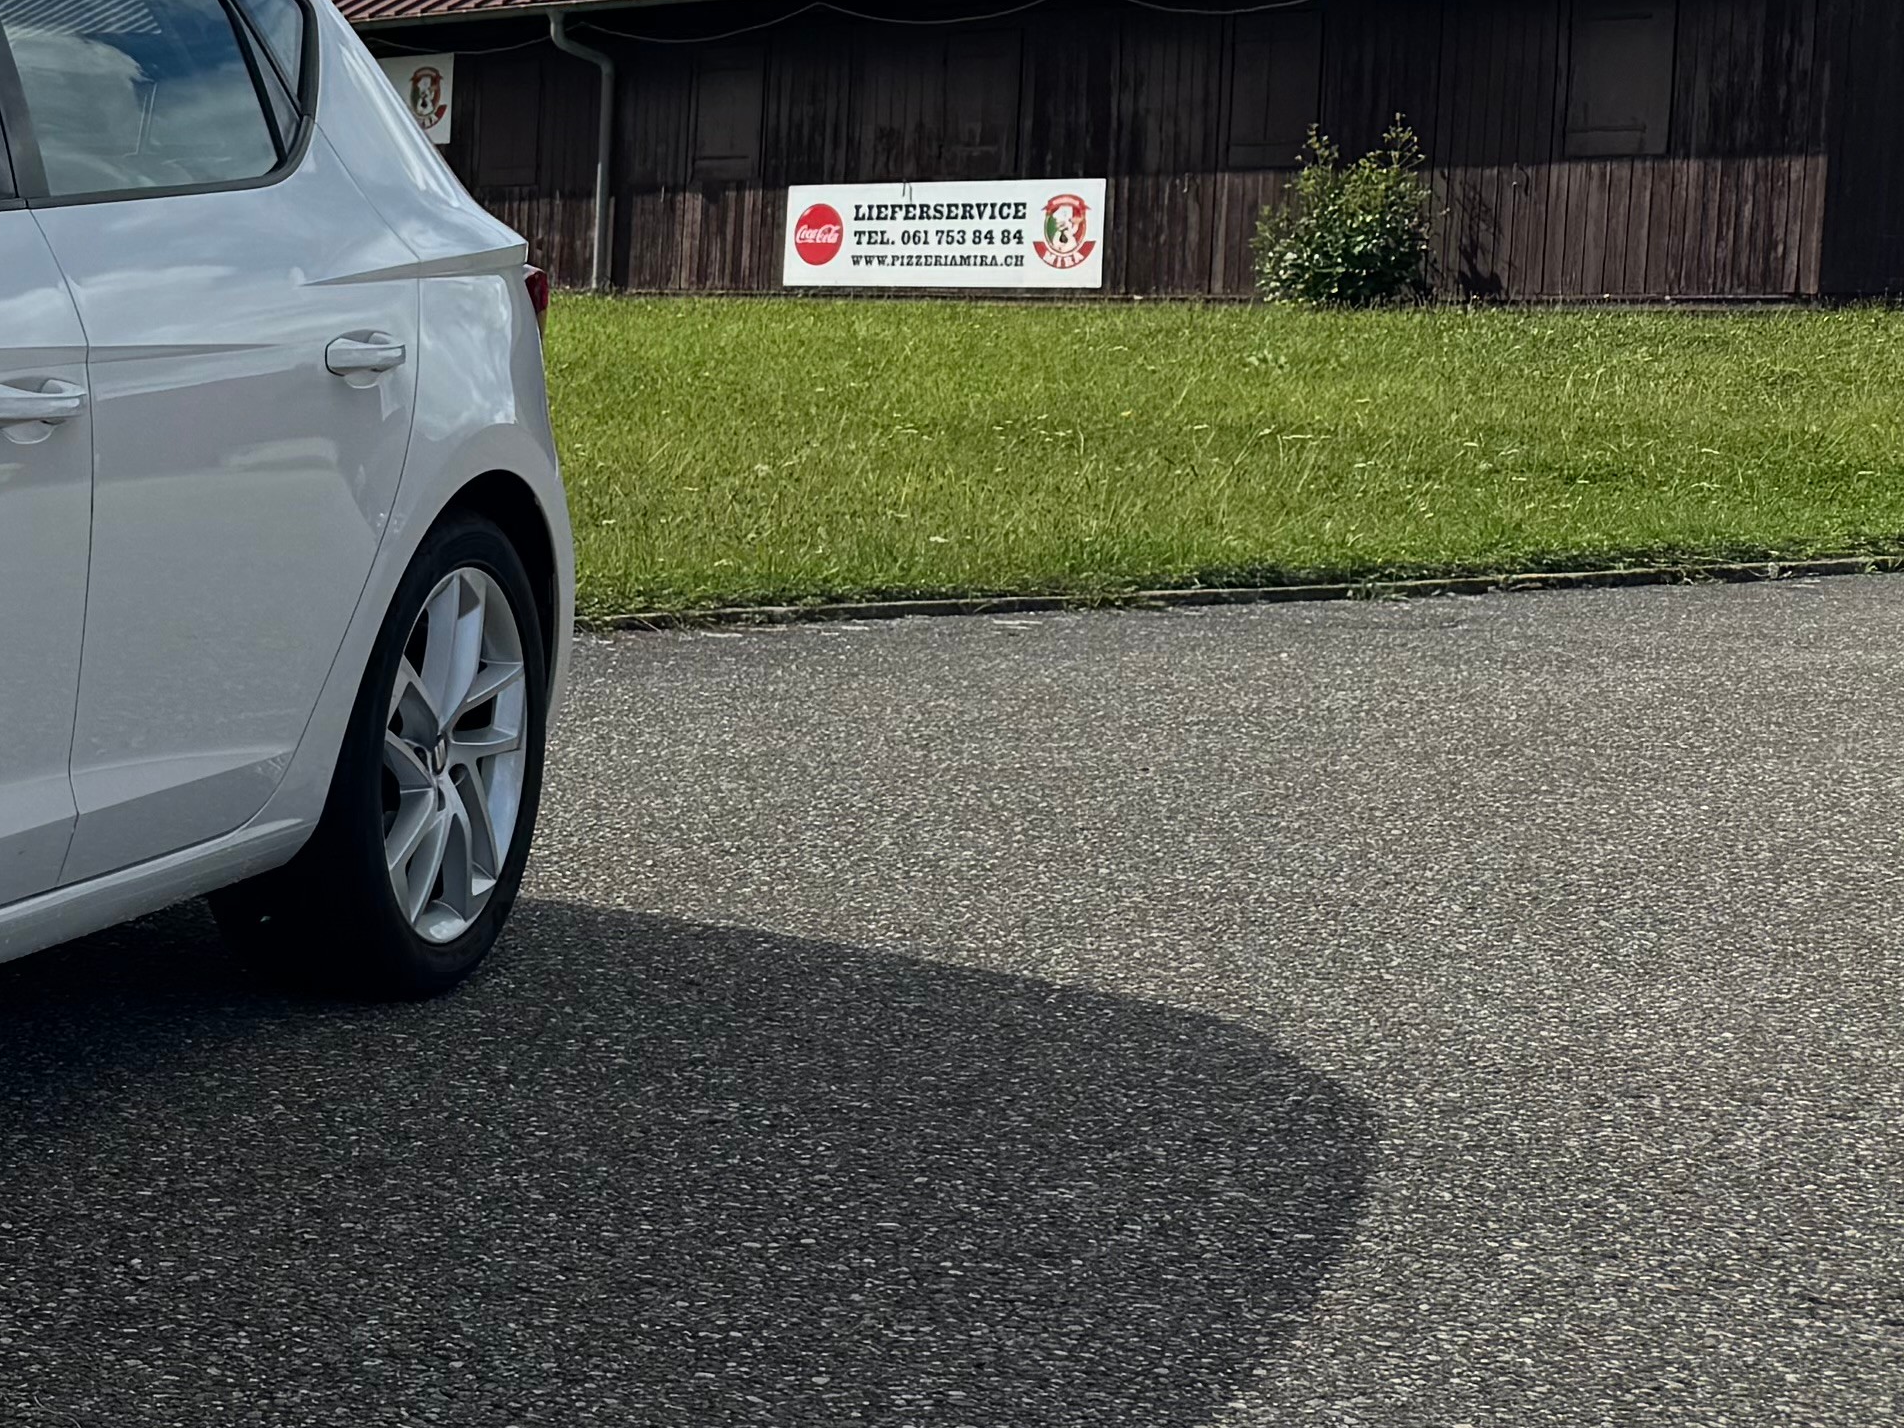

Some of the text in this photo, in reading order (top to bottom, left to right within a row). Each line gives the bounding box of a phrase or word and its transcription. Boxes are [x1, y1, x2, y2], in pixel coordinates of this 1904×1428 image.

[853, 202, 1027, 221] LIEFERSERVICE
[853, 229, 1025, 246] TEL. 061 753 84 84
[851, 254, 1025, 267] WWW.PIZZERIAMIRA.CH
[1043, 251, 1084, 269] MIRA
